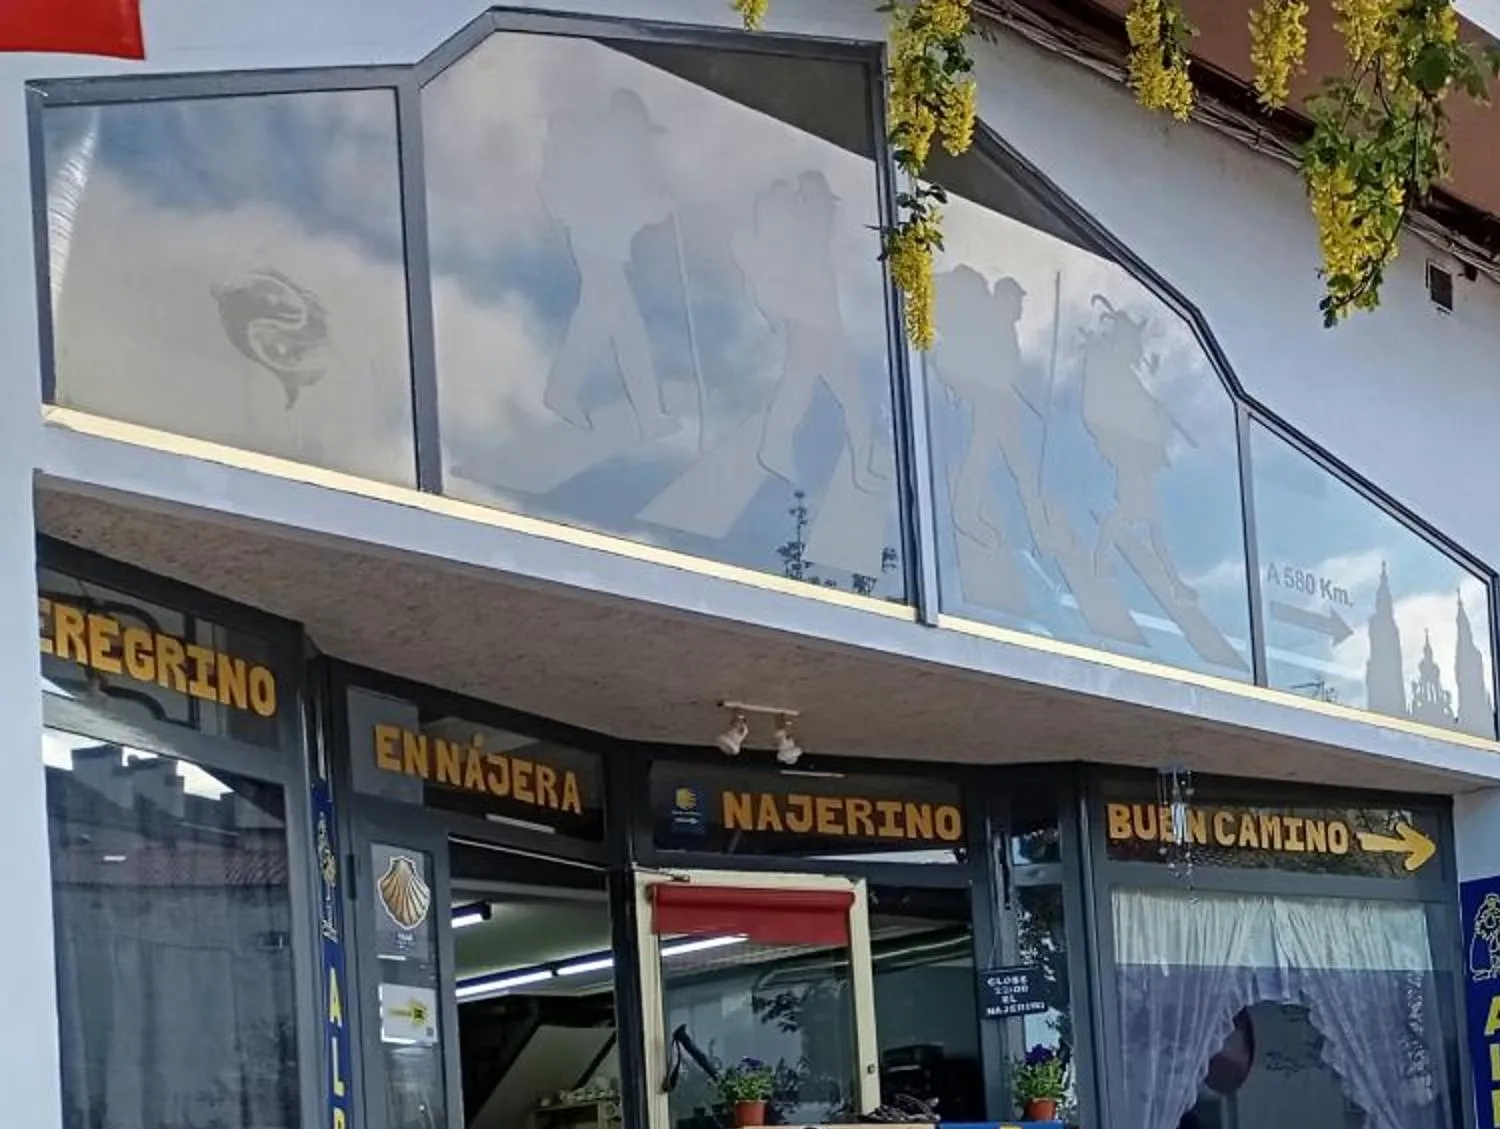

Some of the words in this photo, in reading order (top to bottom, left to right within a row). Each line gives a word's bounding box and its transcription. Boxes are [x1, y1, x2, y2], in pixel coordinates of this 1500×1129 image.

[1267, 562, 1280, 585] A
[1283, 567, 1315, 595] 580
[375, 724, 428, 778] EN
[436, 732, 581, 814] NÁJERA
[722, 791, 962, 841] NAJERINO
[1107, 803, 1207, 846] BUEN
[1214, 811, 1349, 854] CAMINO
